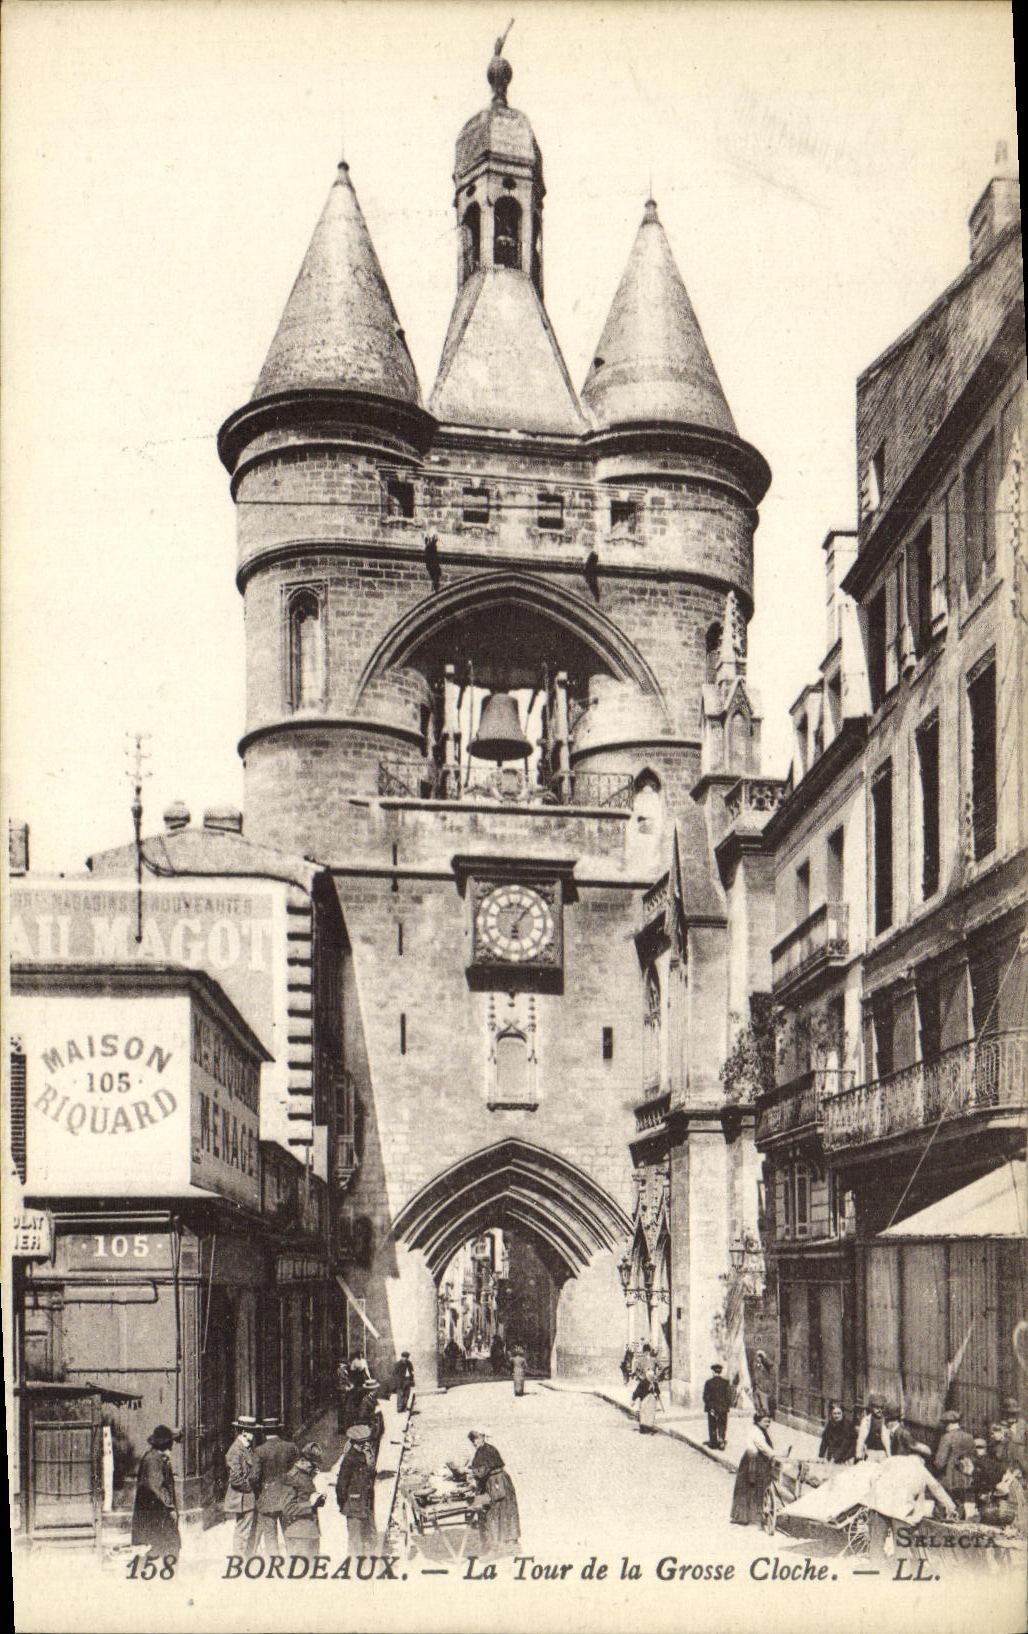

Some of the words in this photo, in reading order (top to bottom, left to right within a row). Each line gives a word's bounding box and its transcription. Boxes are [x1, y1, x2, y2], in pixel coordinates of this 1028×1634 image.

[92, 915, 271, 971] MAGOT
[41, 1034, 173, 1074] MAISON
[33, 1083, 178, 1136] RIQUARD
